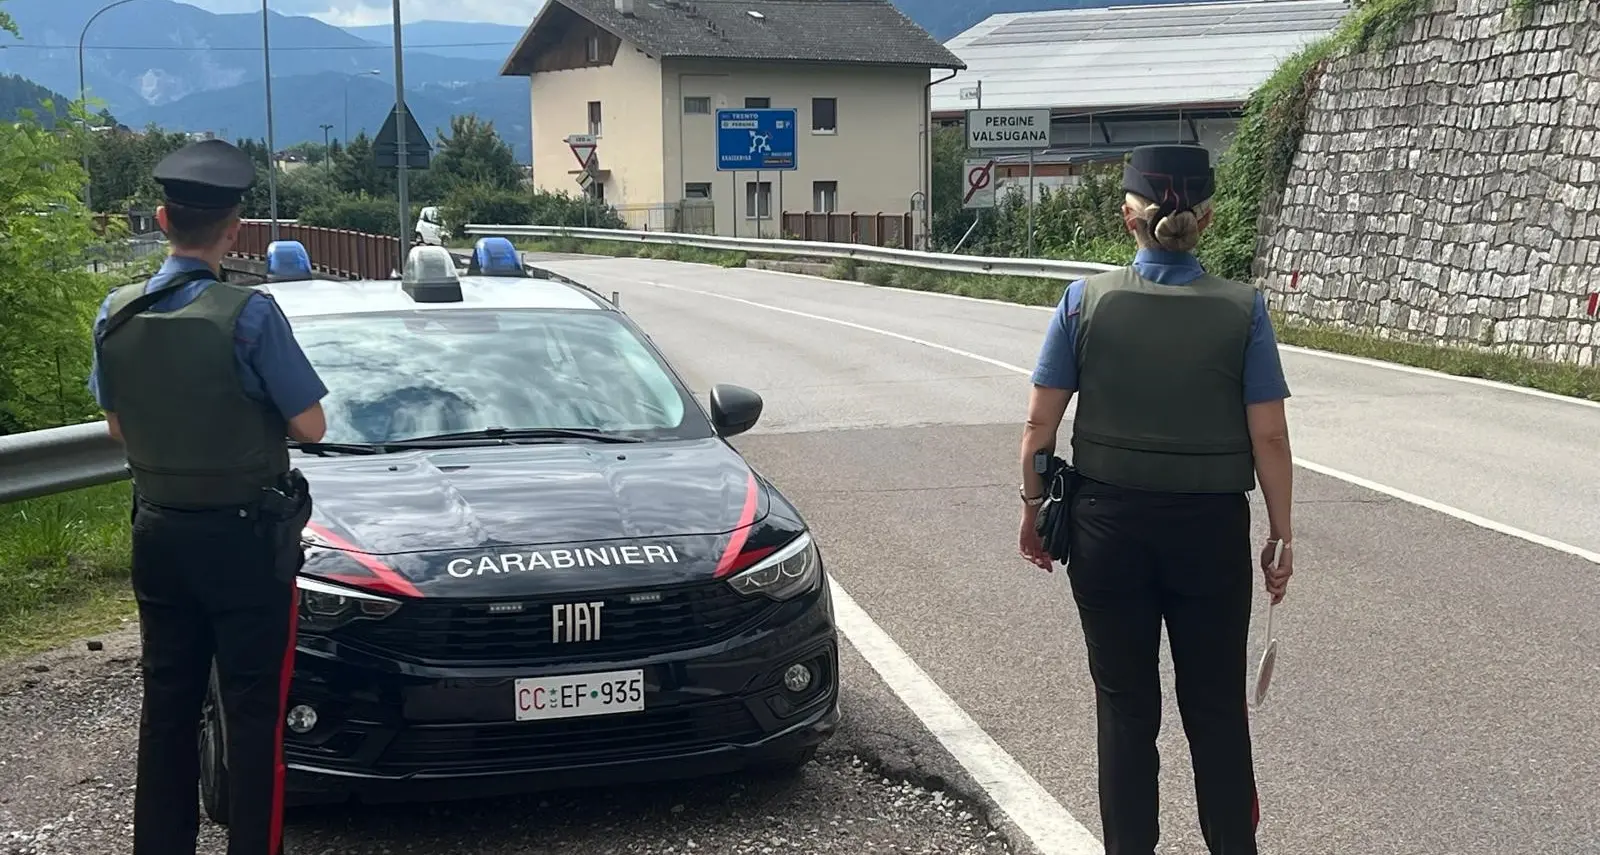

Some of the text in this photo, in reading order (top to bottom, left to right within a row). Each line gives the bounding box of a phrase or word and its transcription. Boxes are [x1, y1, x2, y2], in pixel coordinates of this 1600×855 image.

[972, 130, 1047, 141] VALSUGANA
[985, 116, 1034, 127] PERGINE
[446, 545, 679, 578] CARABINIERI
[552, 601, 605, 644] FIAT
[519, 679, 641, 711] CC EF 935
